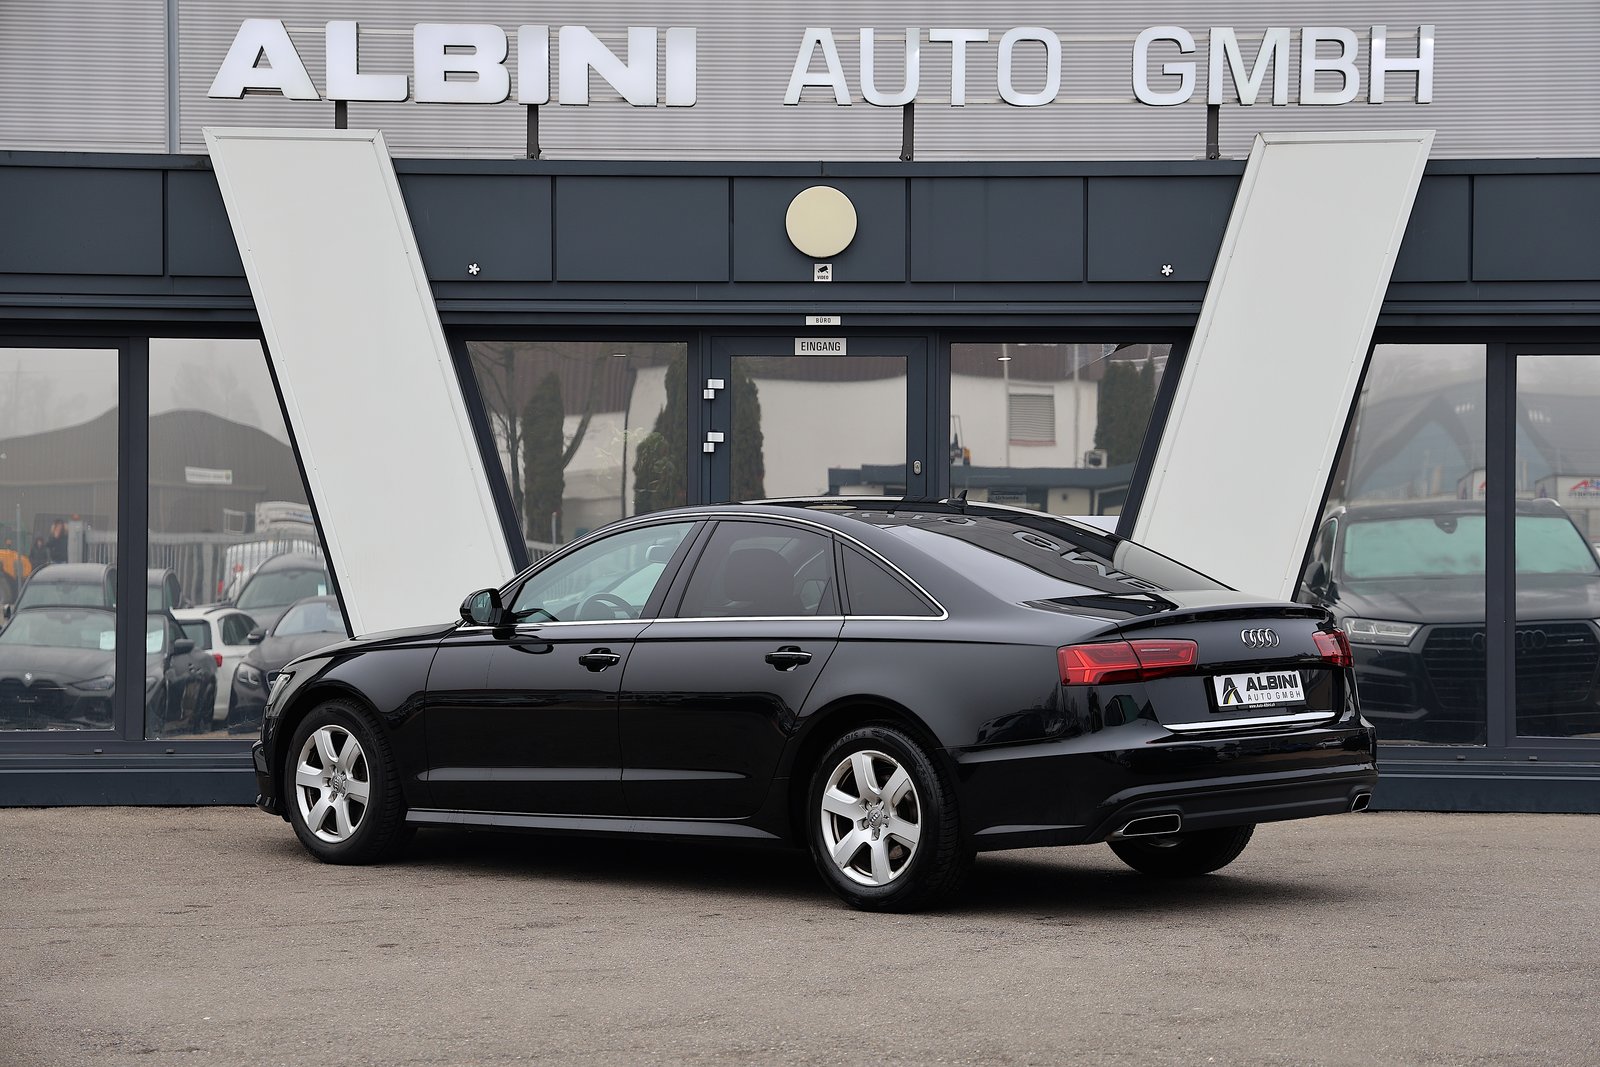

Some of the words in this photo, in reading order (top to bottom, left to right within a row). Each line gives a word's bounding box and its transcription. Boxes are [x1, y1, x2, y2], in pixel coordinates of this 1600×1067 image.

[208, 18, 697, 107] ALBINI
[783, 26, 1062, 106] AUTO
[1131, 25, 1436, 106] GMBH
[800, 341, 841, 352] EINGANG
[1246, 674, 1298, 691] ALBINI
[1247, 692, 1272, 702] AUTO
[1275, 690, 1301, 700] GMBH
